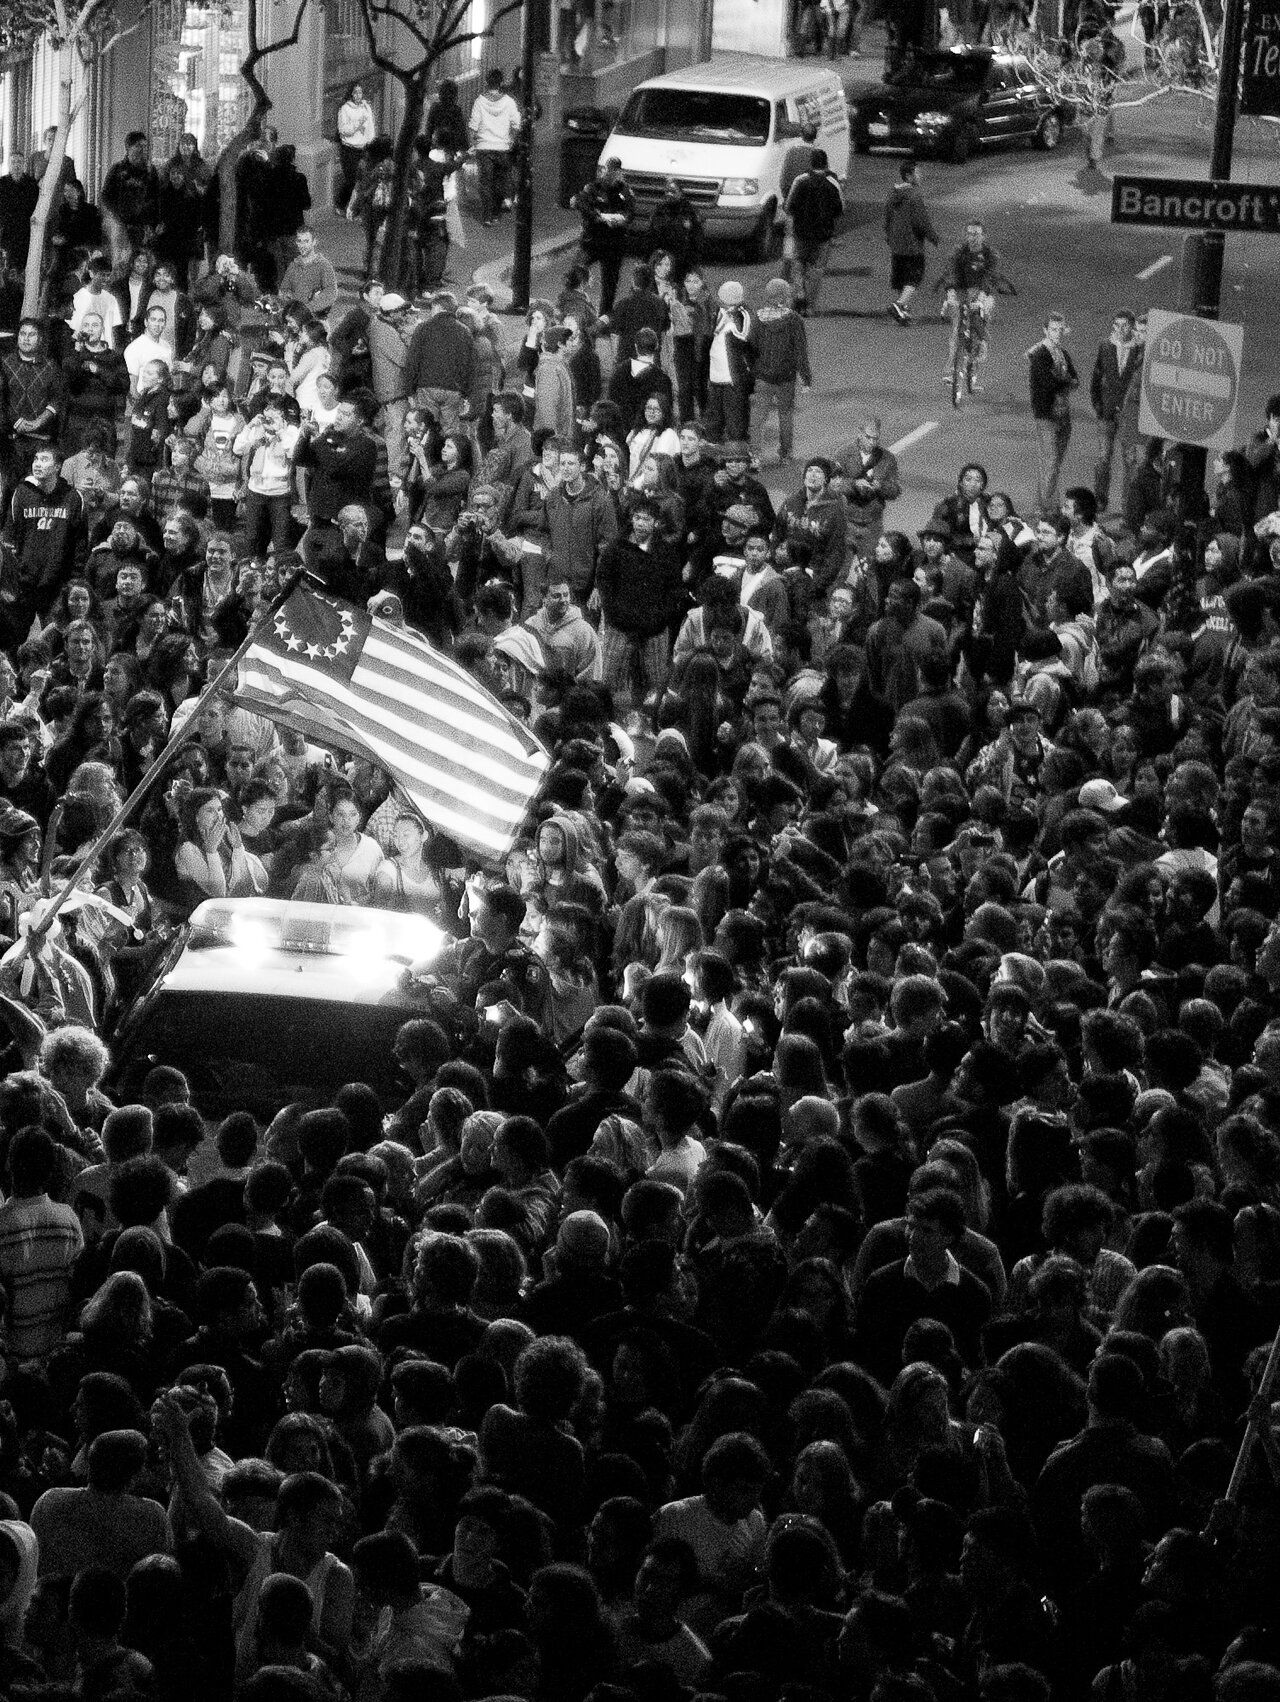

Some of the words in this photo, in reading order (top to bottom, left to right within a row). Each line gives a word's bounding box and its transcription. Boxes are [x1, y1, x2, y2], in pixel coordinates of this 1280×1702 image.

[1253, 34, 1280, 76] Te
[1120, 186, 1264, 222] Bancroft
[1160, 340, 1181, 359] DO
[1193, 344, 1224, 369] NOT
[1160, 393, 1215, 421] ENTER
[23, 506, 67, 519] CALIFORNIA
